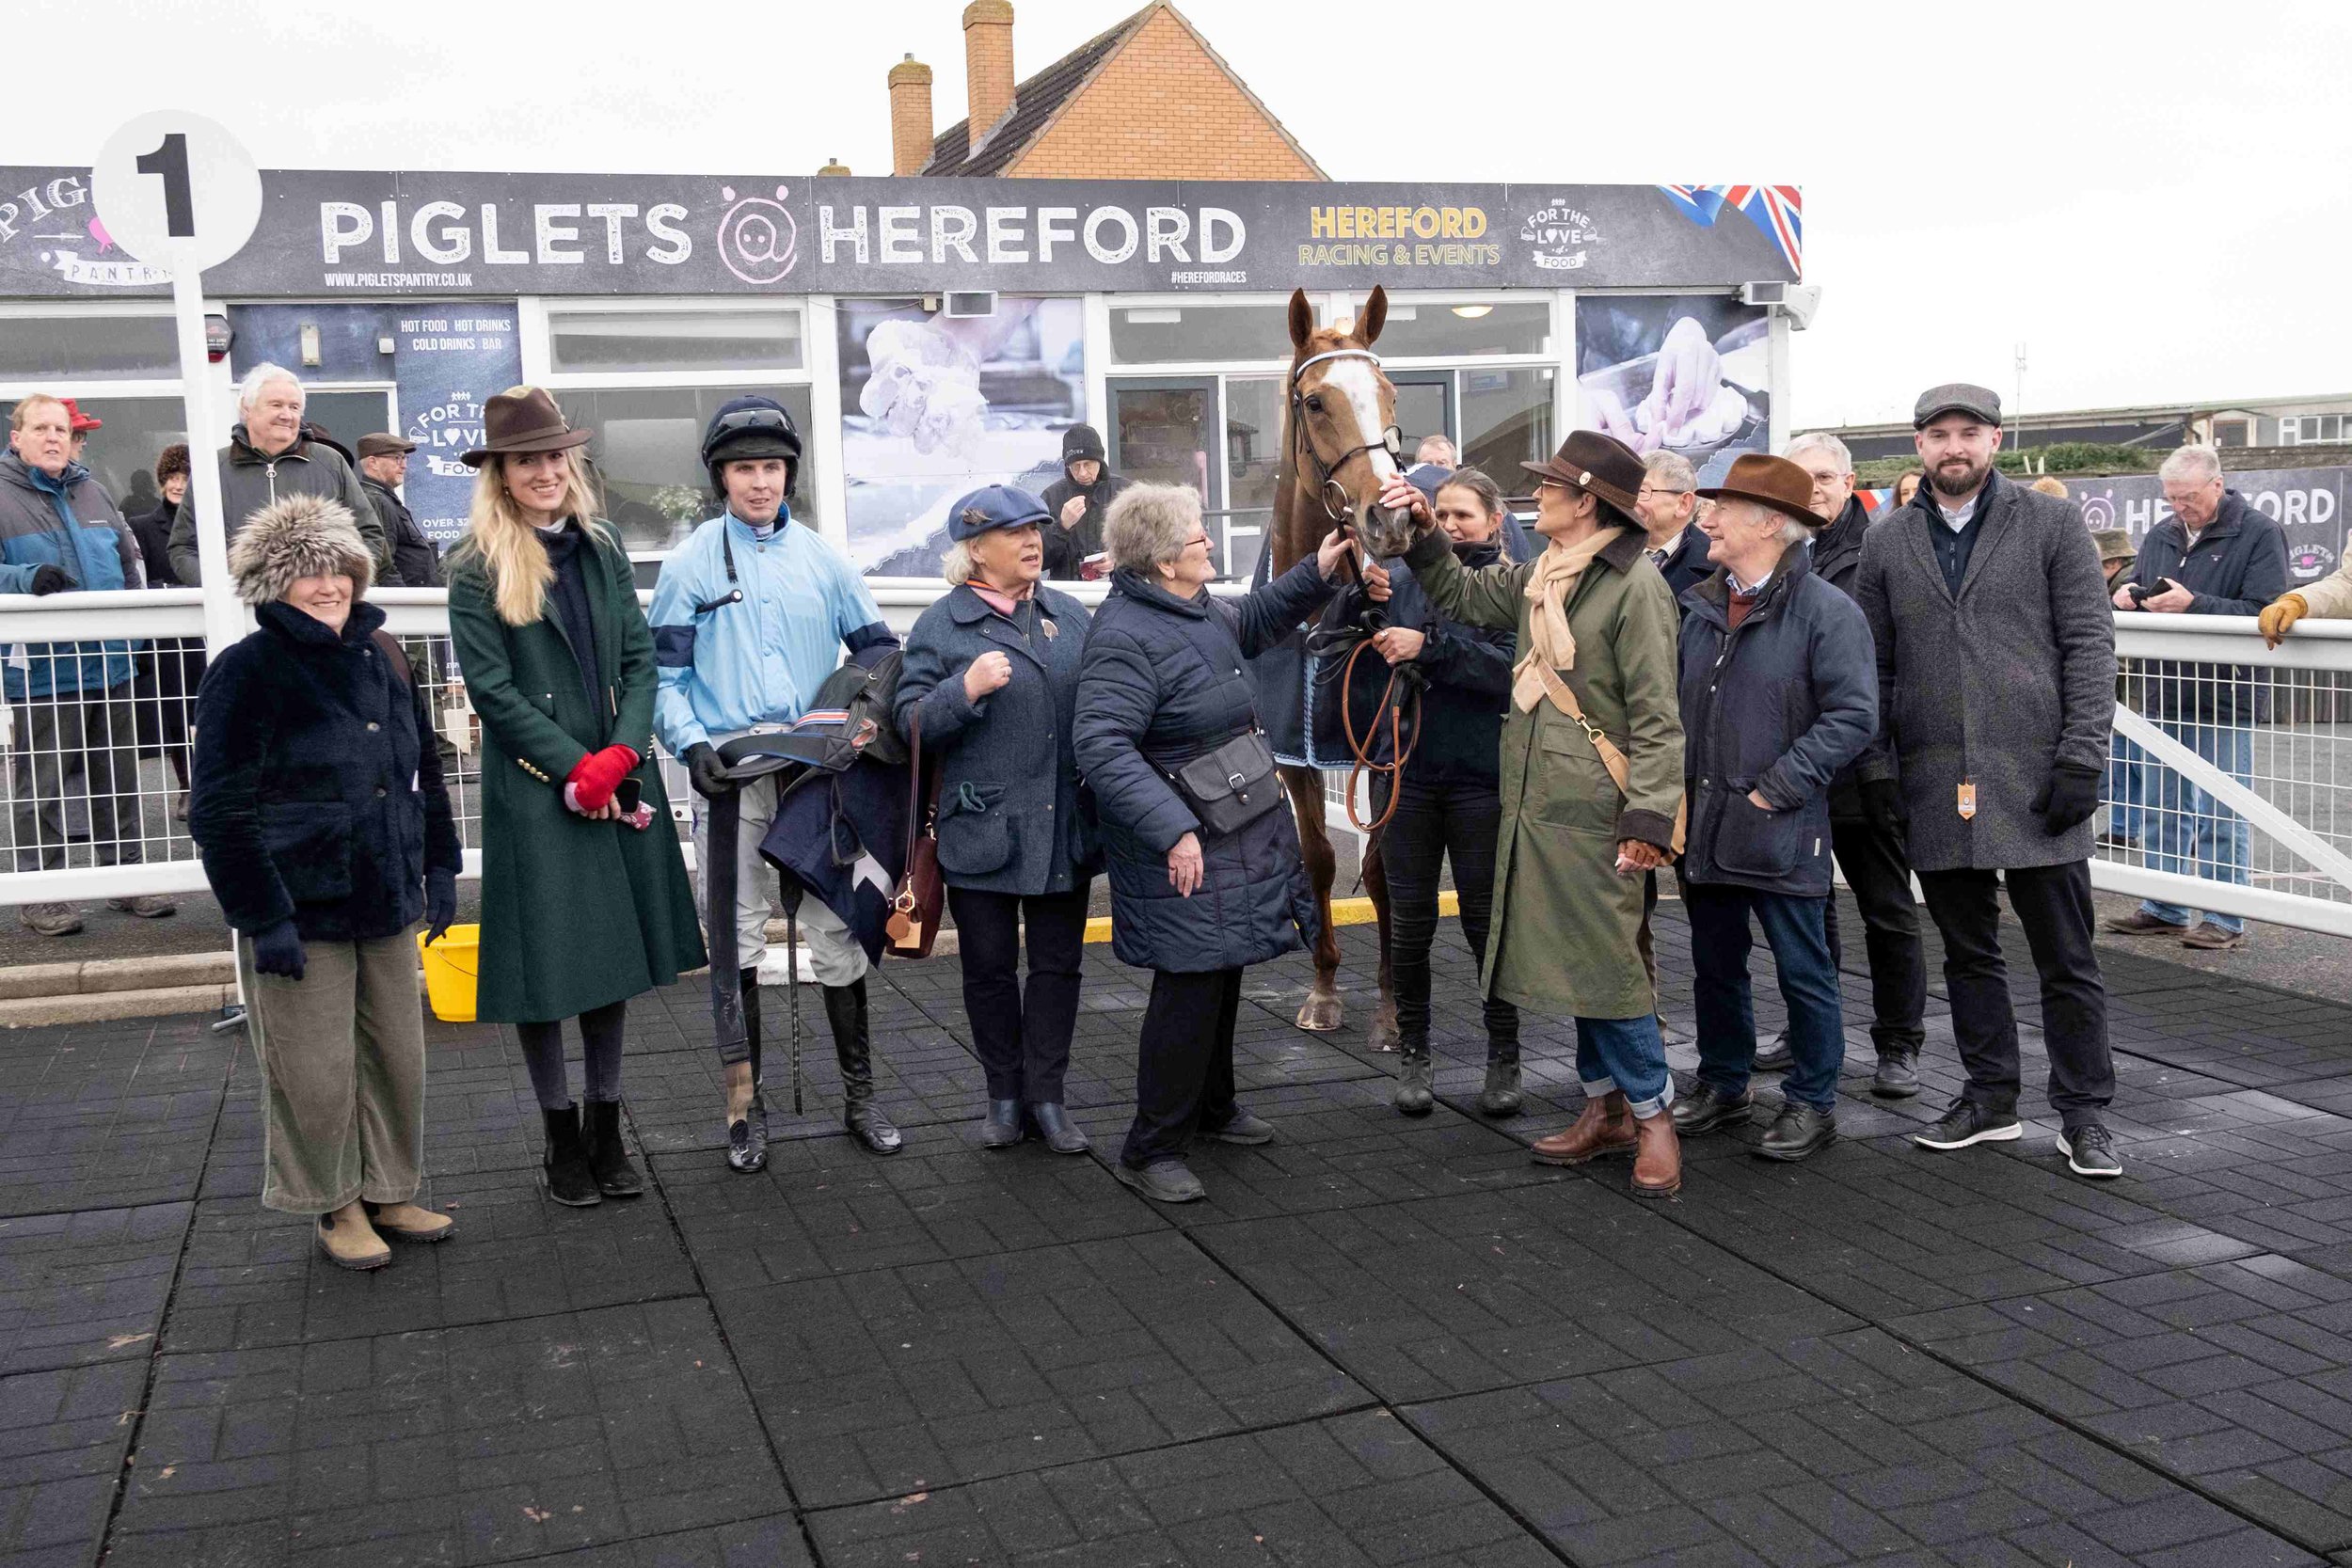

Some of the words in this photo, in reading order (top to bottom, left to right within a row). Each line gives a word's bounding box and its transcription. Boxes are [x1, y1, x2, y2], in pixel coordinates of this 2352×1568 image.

[136, 134, 194, 236] 1
[1311, 206, 1486, 238] HEREFORD
[1527, 208, 1557, 229] FOR
[1562, 208, 1590, 229] THE
[321, 200, 691, 264] PIGLETS
[820, 205, 1246, 263] HEREFORD
[1298, 245, 1388, 265] RACING
[1393, 245, 1410, 265] &
[1416, 245, 1500, 265] EVENTS
[1544, 258, 1577, 267] FOOD
[325, 274, 472, 287] WWW.PIGLETSPANTRY.CO.UK
[1171, 271, 1247, 284] #HEREFORDRACES
[401, 321, 420, 332] HOT
[422, 320, 448, 331] FOOD
[454, 320, 474, 331] HOT
[476, 320, 511, 331] DRINKS
[413, 339, 438, 351] COLD
[440, 338, 476, 350] DRINKS
[482, 338, 501, 350] BAR
[417, 404, 461, 429] FOR
[443, 463, 478, 474] FOO
[422, 518, 454, 528] OVER
[427, 531, 460, 539] FOOD
